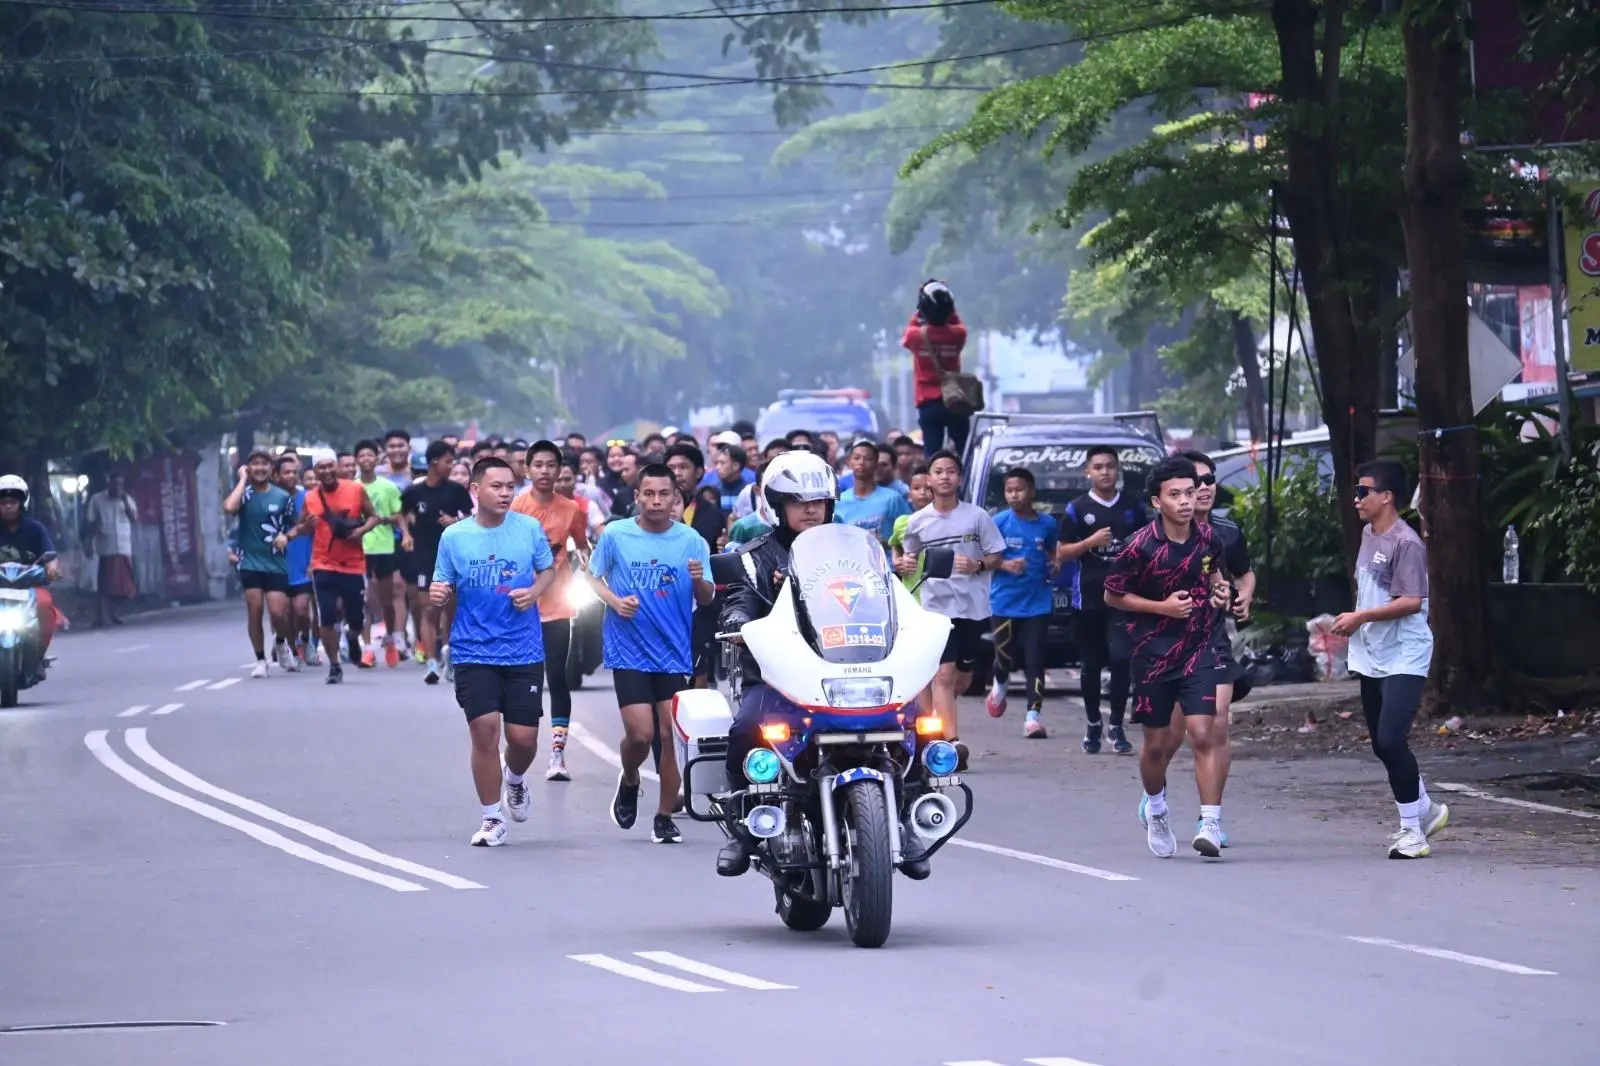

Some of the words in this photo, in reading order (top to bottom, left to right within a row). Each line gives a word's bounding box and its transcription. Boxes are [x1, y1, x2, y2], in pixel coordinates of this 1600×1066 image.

[801, 471, 823, 488] PM
[469, 564, 502, 587] RUN
[629, 568, 663, 590] RUN
[800, 562, 832, 600] POLISI
[838, 559, 889, 598] MILITER
